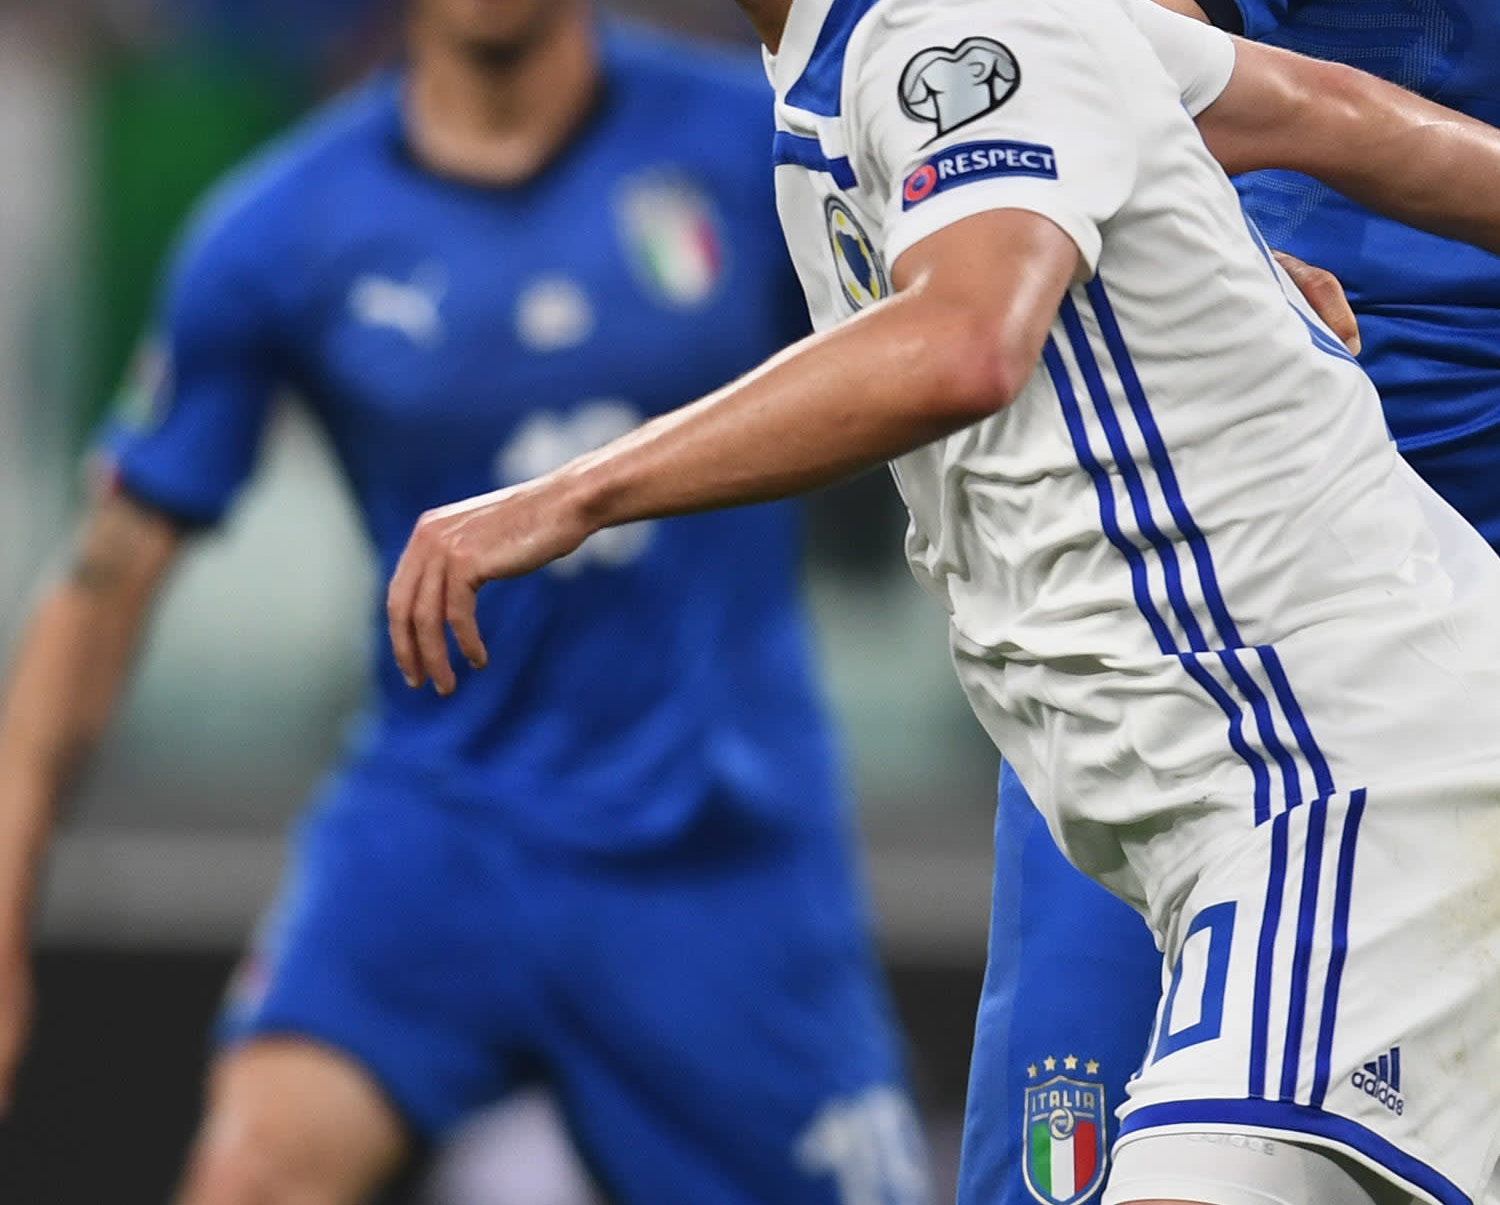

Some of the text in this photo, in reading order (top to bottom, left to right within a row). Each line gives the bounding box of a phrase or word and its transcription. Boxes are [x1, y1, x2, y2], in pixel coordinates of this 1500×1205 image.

[937, 148, 1054, 179] RESPECT
[1032, 1090, 1095, 1113] ITALIA
[1351, 1071, 1404, 1116] adidas
